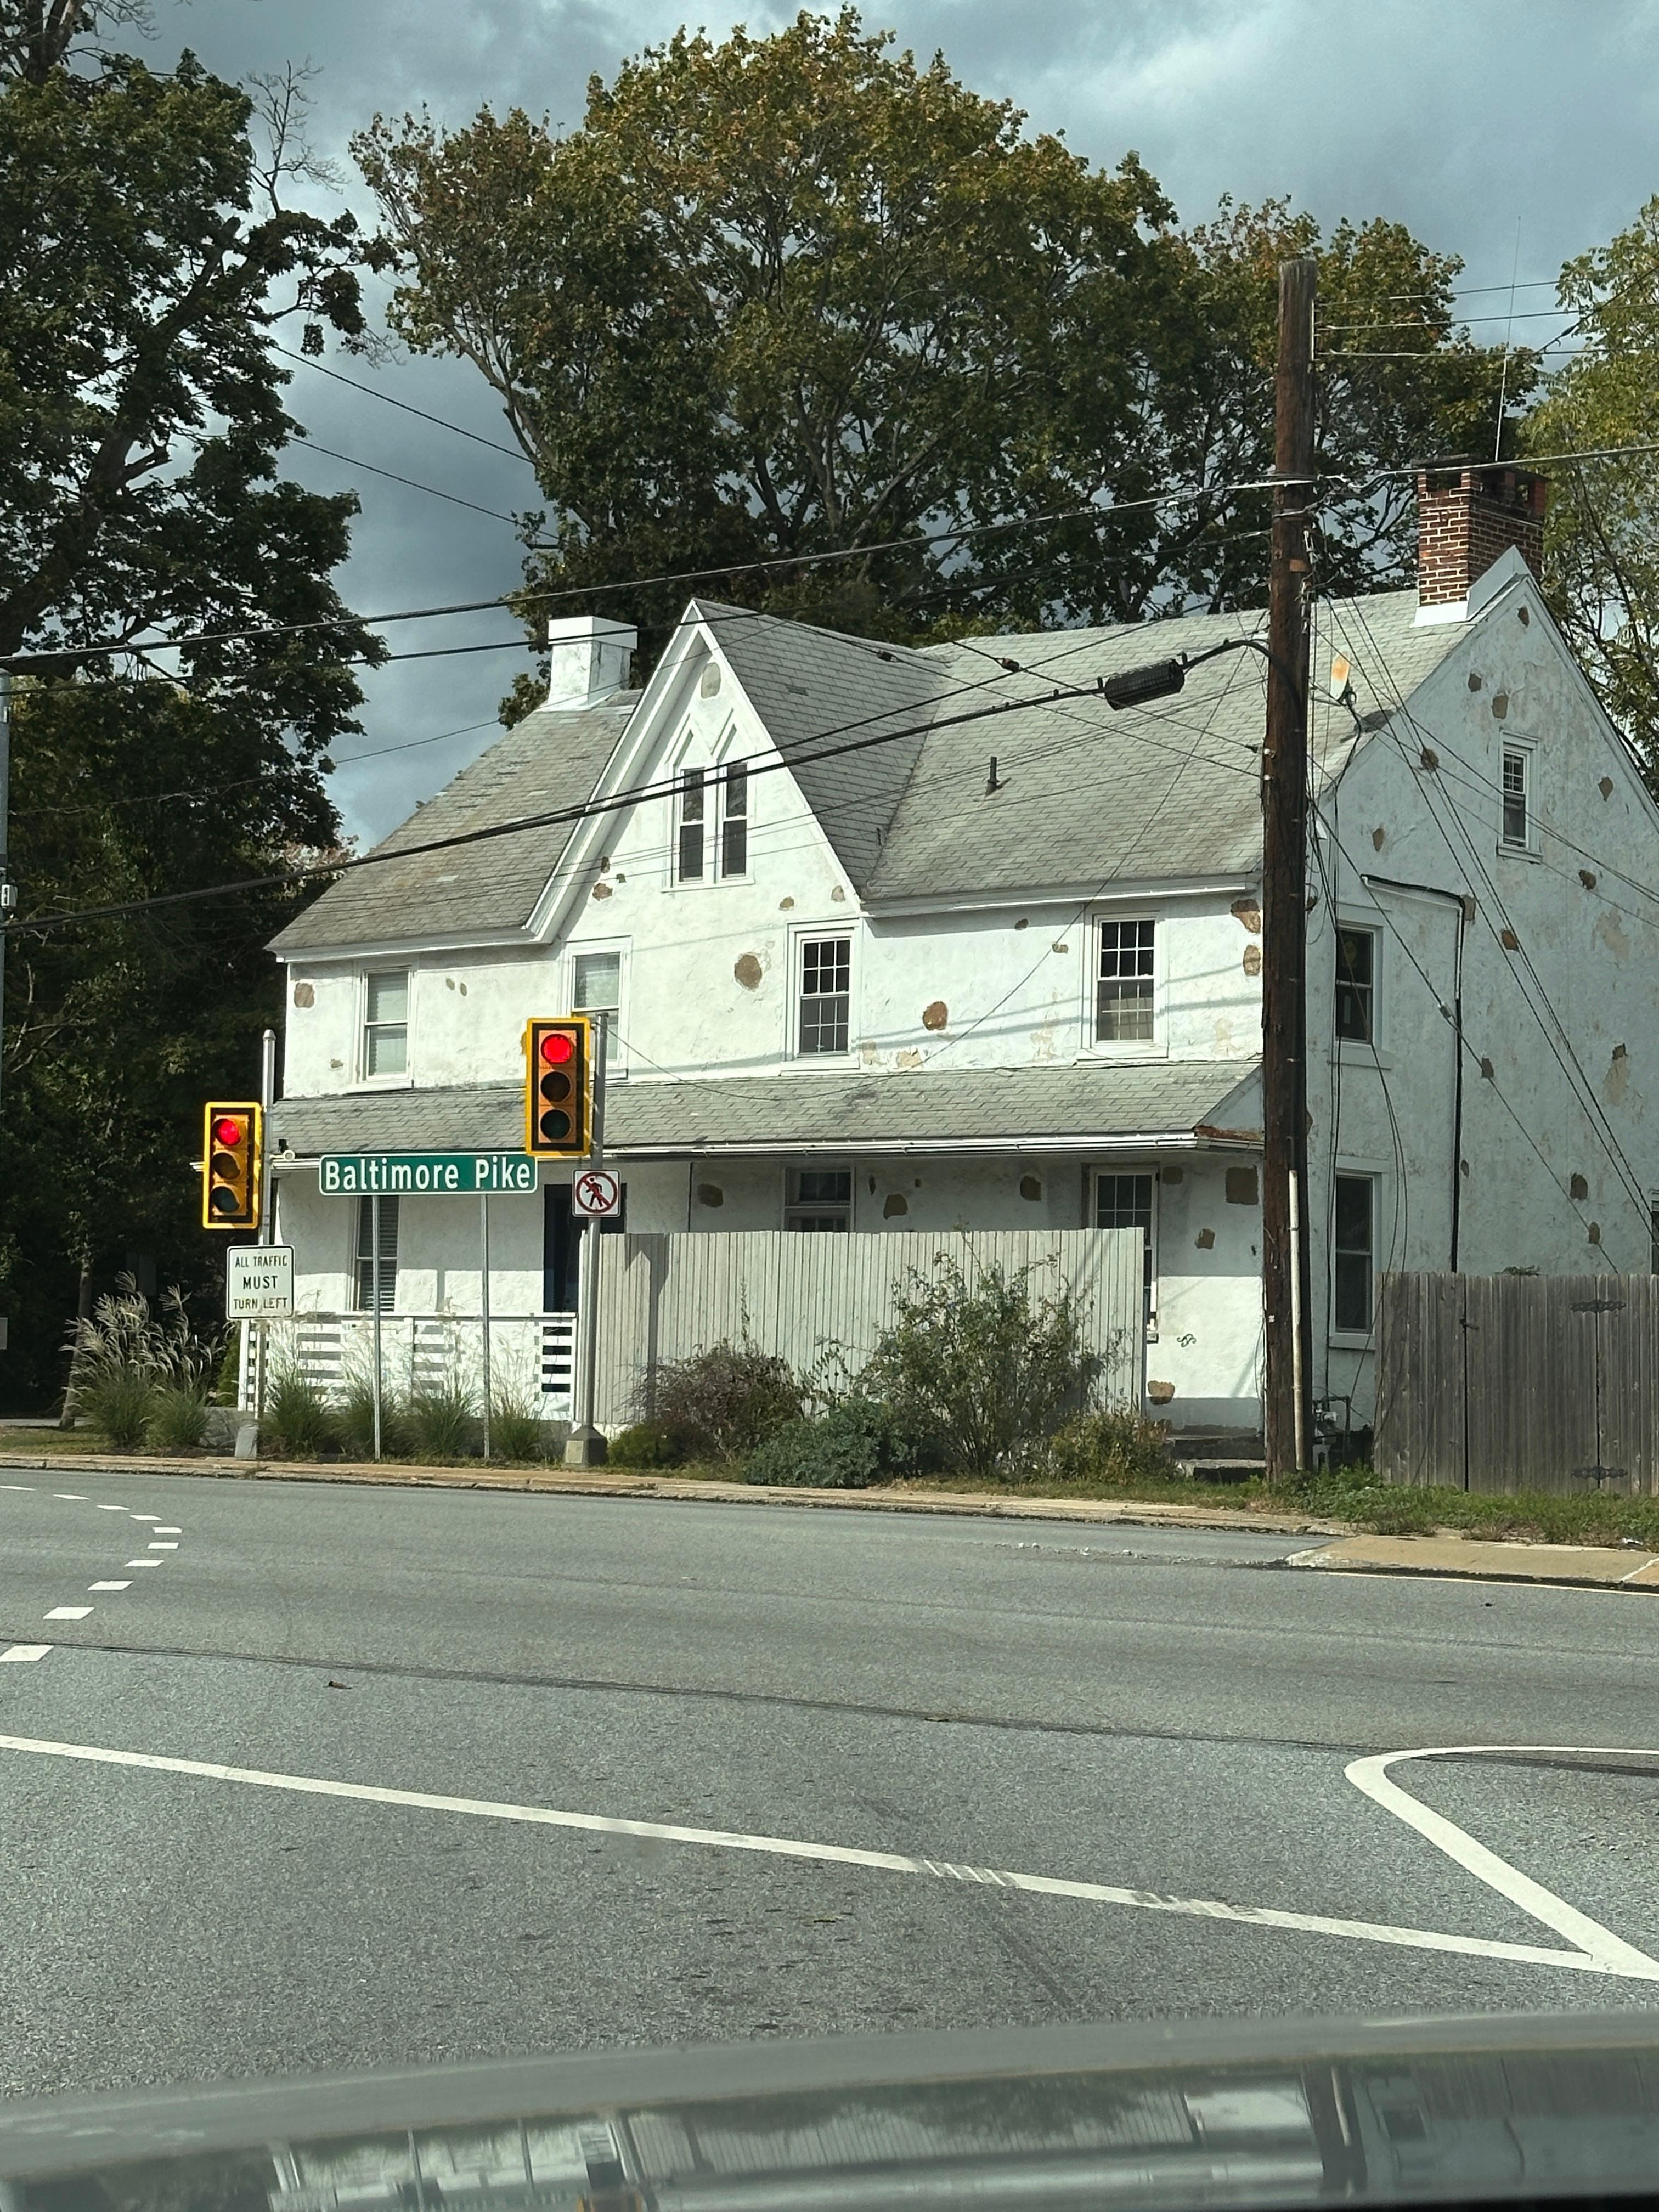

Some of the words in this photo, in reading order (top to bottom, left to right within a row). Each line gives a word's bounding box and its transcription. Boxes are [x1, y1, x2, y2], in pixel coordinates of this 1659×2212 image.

[325, 1158, 459, 1190] Baltimore
[475, 1156, 530, 1189] Pike
[235, 1257, 249, 1268] ALL
[253, 1255, 287, 1267] TRAFFIC
[243, 1275, 278, 1290] MUST
[233, 1298, 258, 1310] TURN
[263, 1297, 287, 1309] LEFT
